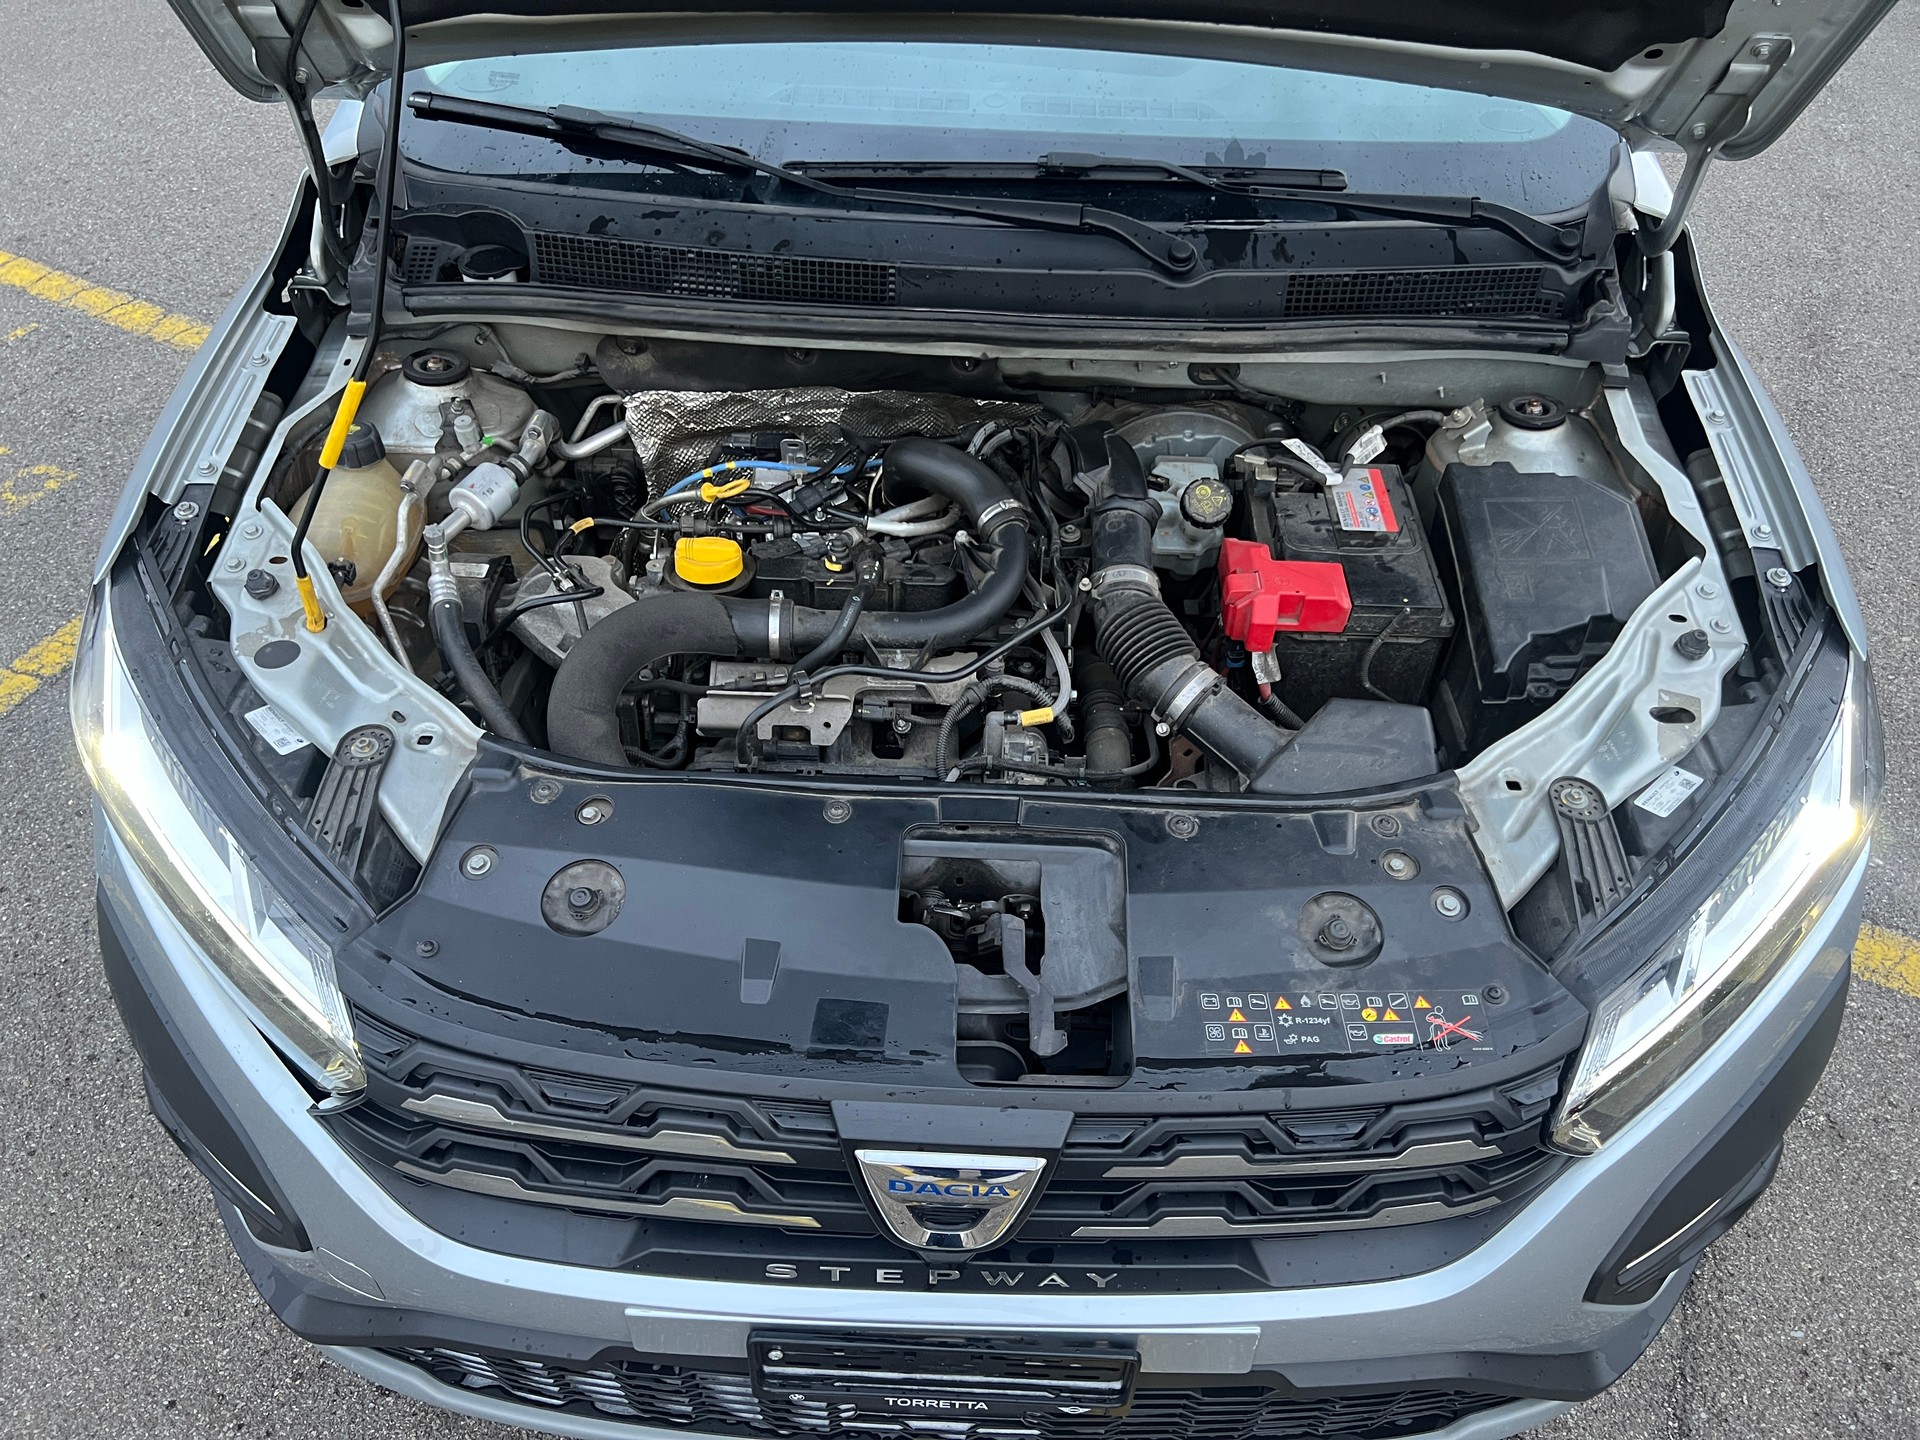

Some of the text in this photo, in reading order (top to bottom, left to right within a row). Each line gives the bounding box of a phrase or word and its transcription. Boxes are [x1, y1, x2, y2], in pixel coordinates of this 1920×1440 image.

[1384, 1034, 1411, 1043] Castrol
[888, 1179, 1010, 1197] DACIA
[764, 1263, 1119, 1289] STEPWAY
[884, 1396, 989, 1411] TORRETTA
